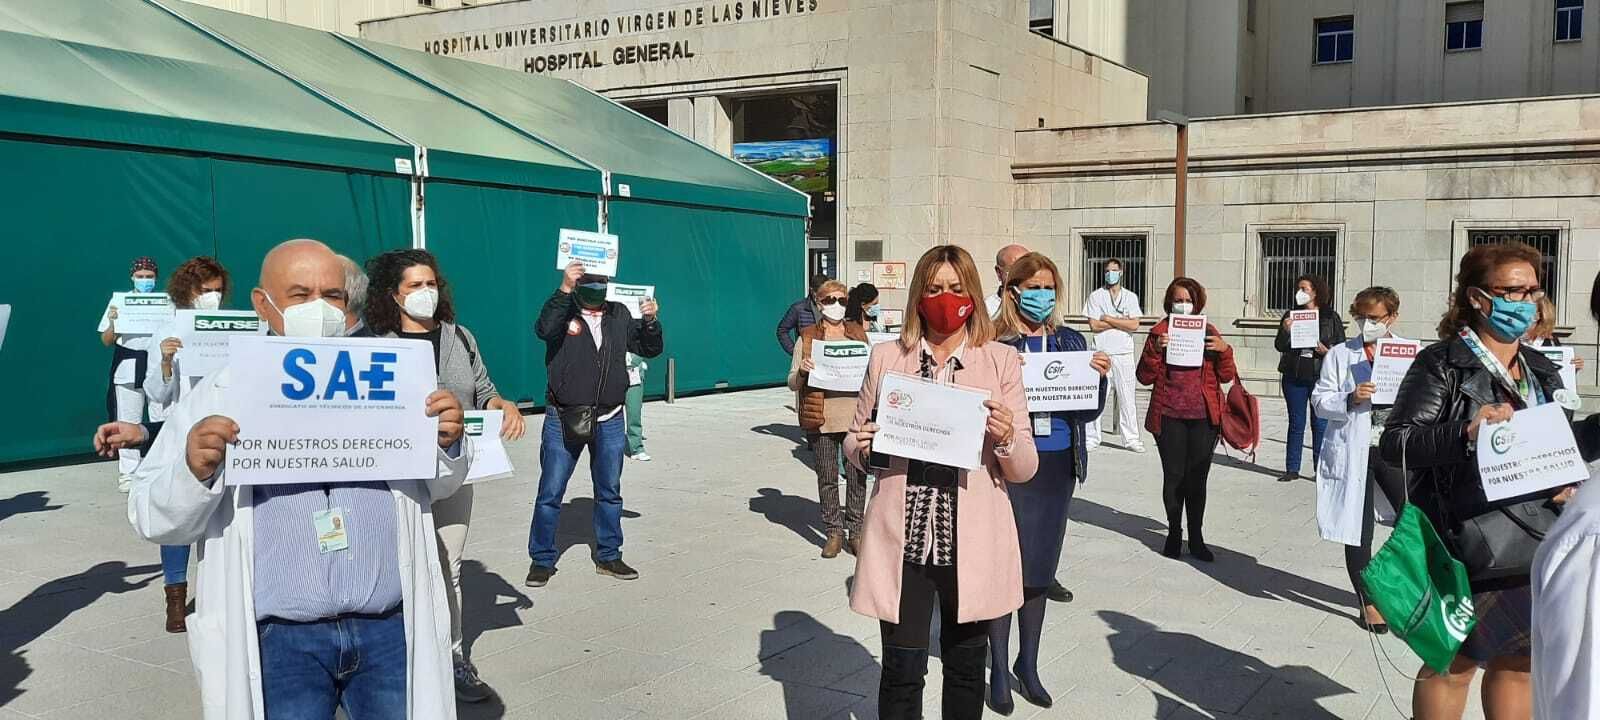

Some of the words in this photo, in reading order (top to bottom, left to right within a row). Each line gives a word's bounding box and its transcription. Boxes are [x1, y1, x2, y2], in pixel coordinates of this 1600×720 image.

[424, 34, 489, 55] HOSPITAL
[495, 19, 610, 49] UNIVERSITARIO
[617, 10, 676, 33] VIRGEN
[684, 7, 704, 26] DE
[711, 2, 743, 23] LAS
[752, 0, 818, 18] NIEVES
[524, 50, 603, 73] HOSPITAL
[612, 40, 695, 65] GENERAL
[195, 319, 259, 330] SATSE
[1174, 319, 1202, 328] CCOO
[824, 347, 868, 356] SATSE
[1382, 345, 1415, 356] CCOO
[233, 438, 263, 450] POR
[267, 438, 339, 450] NUESTROS
[342, 438, 413, 451] DERECHOS,
[232, 458, 261, 469] POR
[266, 457, 329, 469] NUESTRA
[332, 456, 378, 468] SALUD.
[1491, 458, 1527, 473] NUESTR
[1488, 477, 1501, 485] POR
[1450, 596, 1475, 631] CSIF
